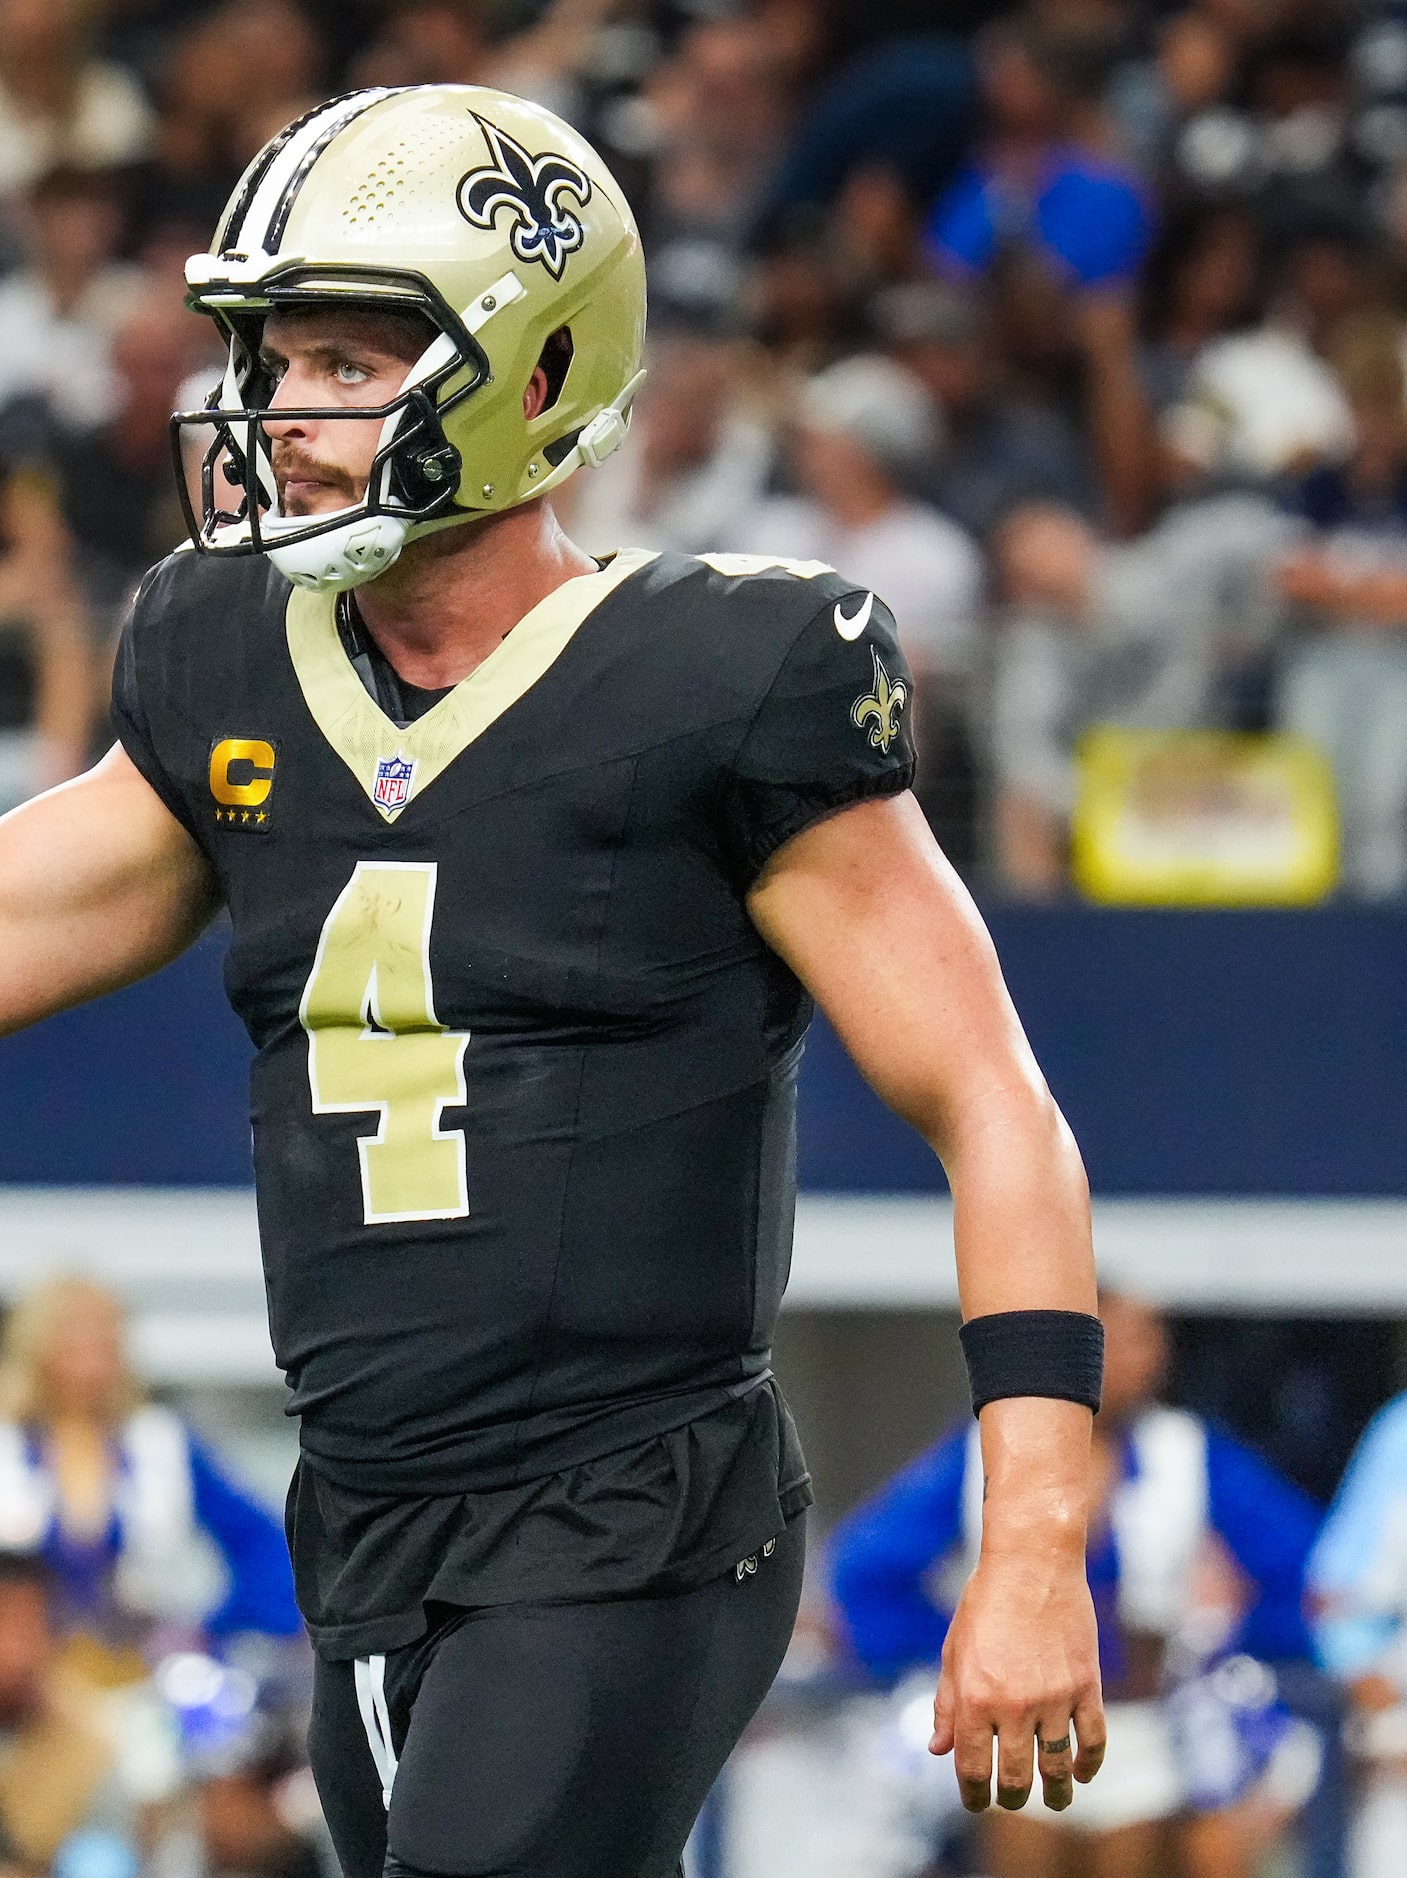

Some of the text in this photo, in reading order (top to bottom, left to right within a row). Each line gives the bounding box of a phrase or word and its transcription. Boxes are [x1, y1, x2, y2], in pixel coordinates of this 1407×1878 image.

[209, 738, 276, 807] C
[377, 779, 404, 803] NFL
[298, 860, 471, 1225] 4
